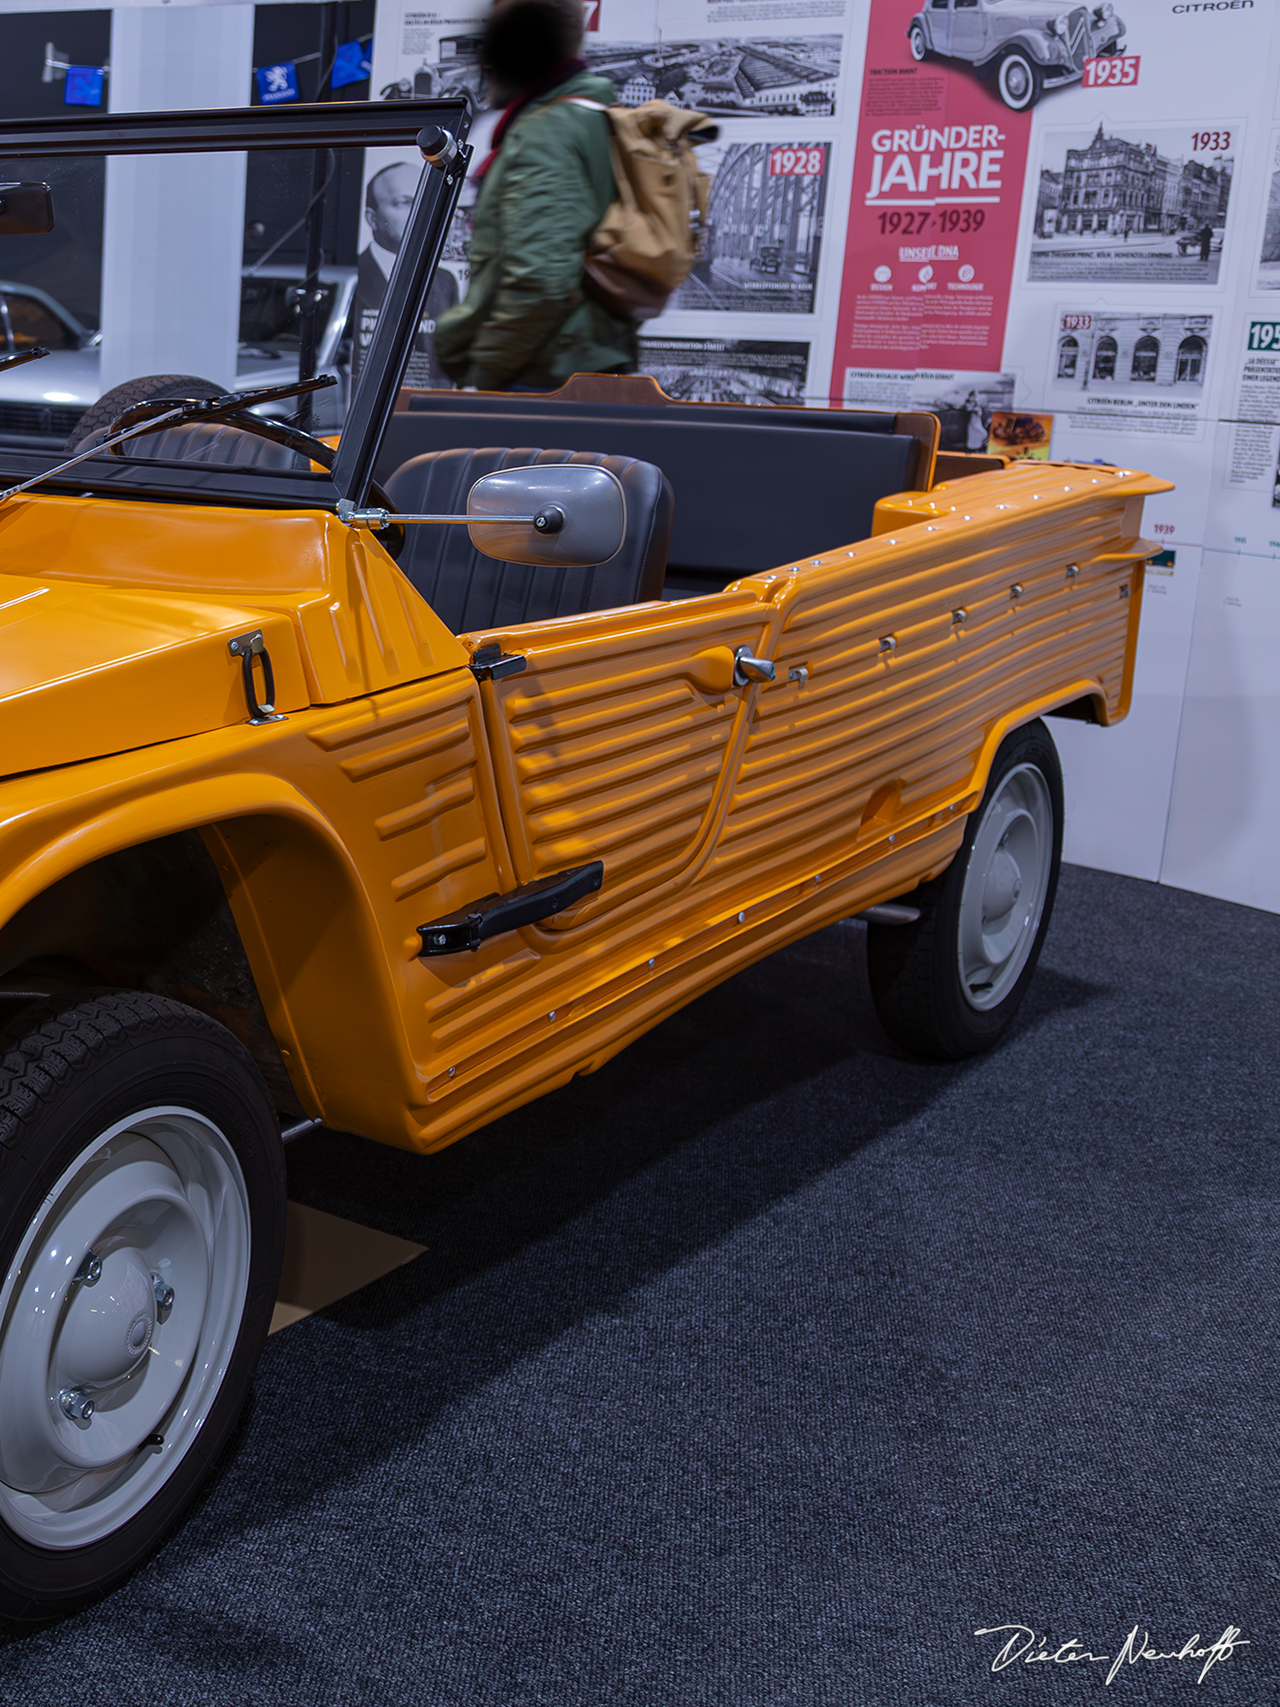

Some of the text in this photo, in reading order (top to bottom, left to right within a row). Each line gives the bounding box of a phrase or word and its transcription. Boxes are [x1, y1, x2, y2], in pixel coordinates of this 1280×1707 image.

[1085, 59, 1136, 86] 1935
[871, 124, 1006, 152] GRÜNDER-
[1191, 131, 1231, 152] 1933
[772, 150, 822, 174] 1928
[866, 151, 1004, 199] JAHRE
[458, 269, 470, 281] 19
[418, 319, 437, 334] ND
[1065, 315, 1091, 329] 1933
[1251, 323, 1280, 350] 195
